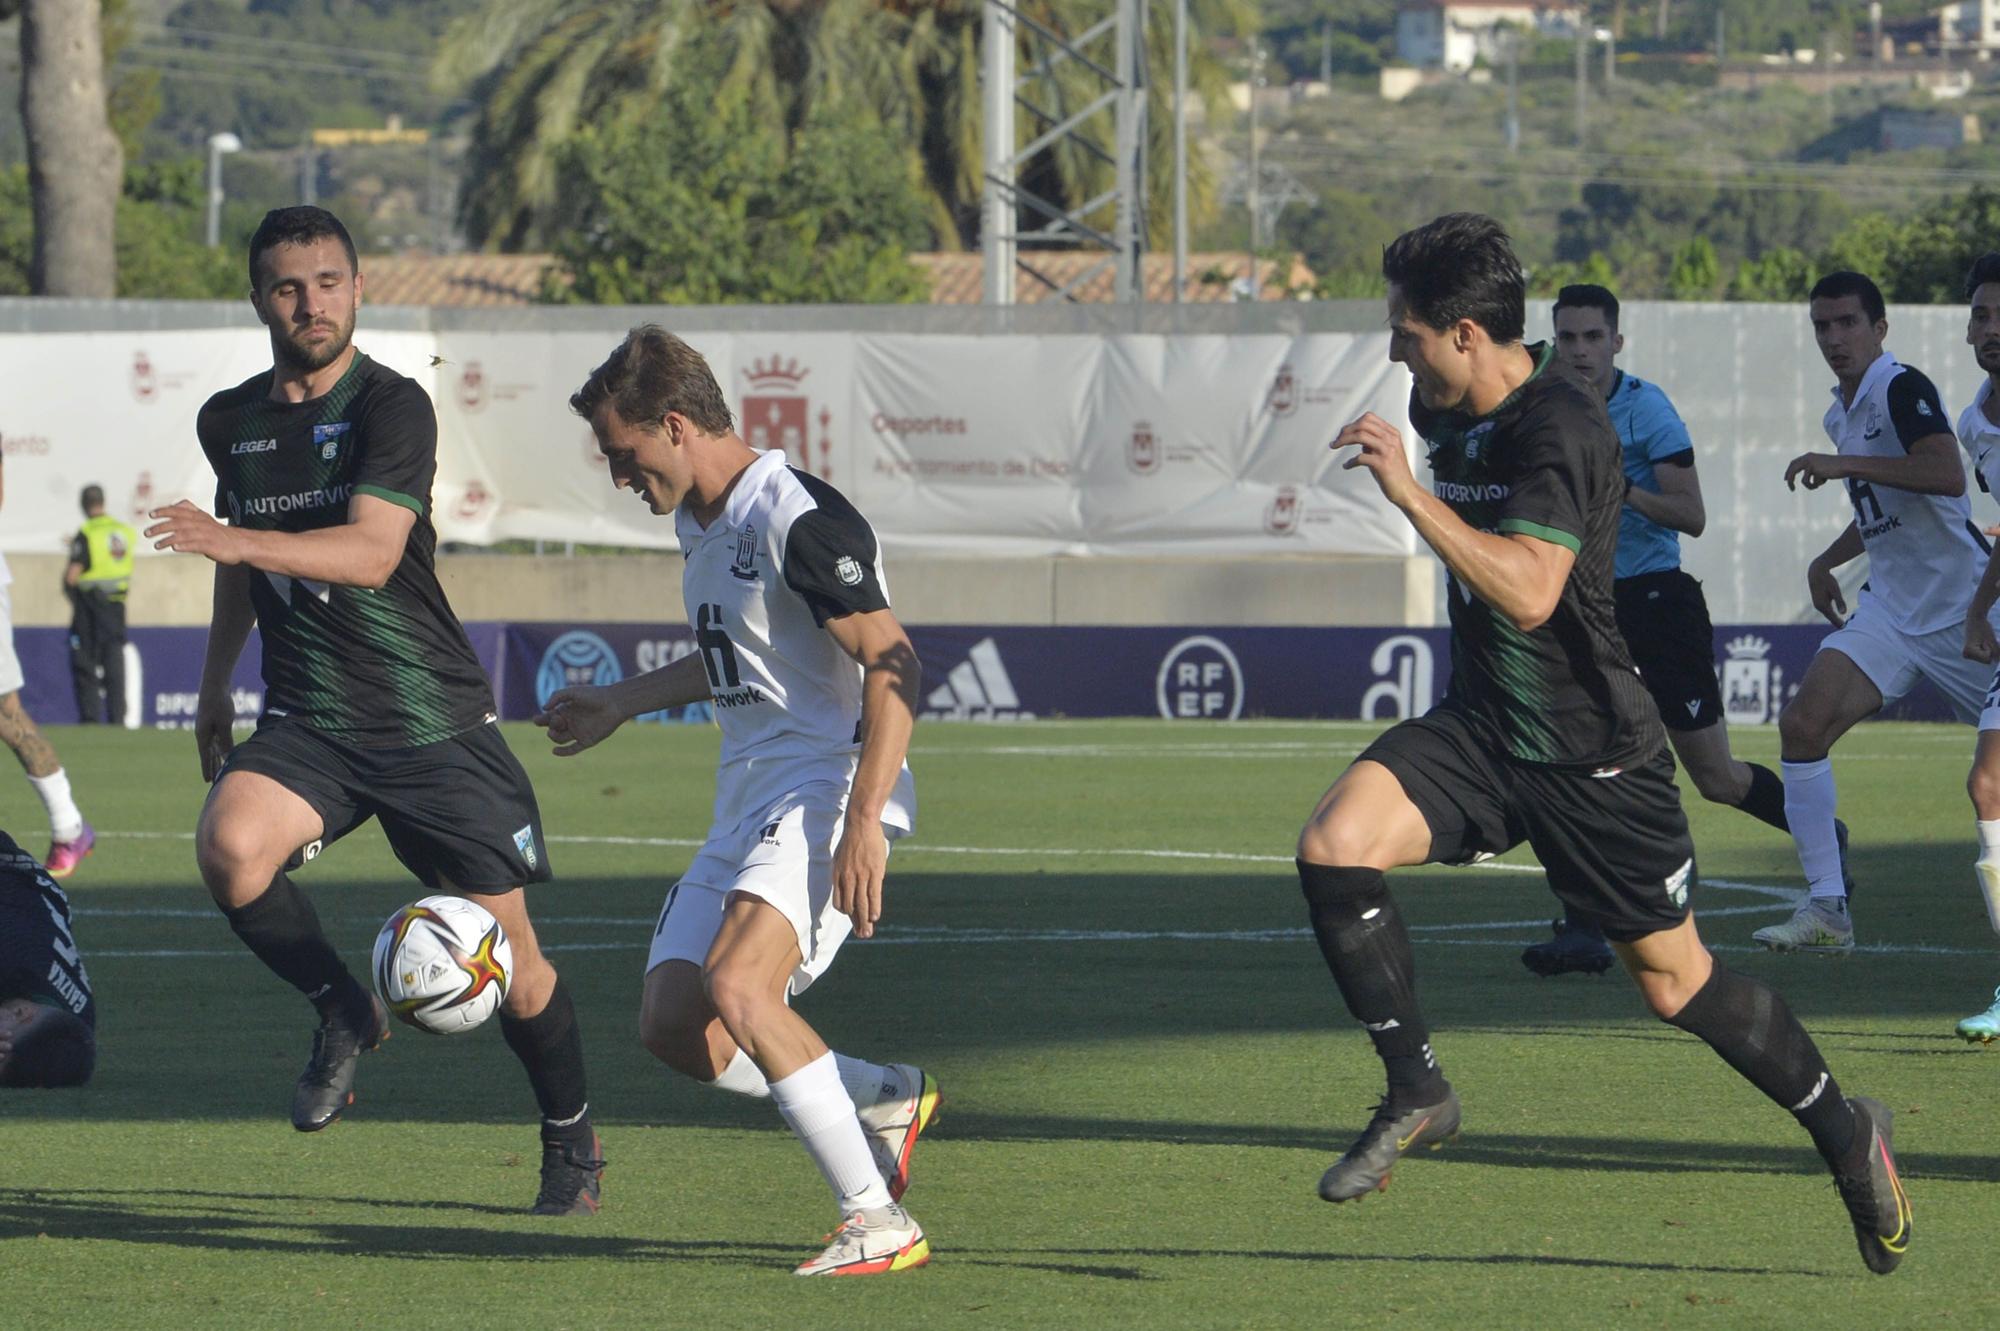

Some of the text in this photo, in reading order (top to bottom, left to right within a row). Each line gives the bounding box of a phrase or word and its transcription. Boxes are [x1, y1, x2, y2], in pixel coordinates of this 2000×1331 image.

[873, 414, 967, 438] Deportes
[231, 439, 277, 454] LEGEA
[1004, 459, 1025, 475] de
[1178, 662, 1224, 687] RF
[1178, 691, 1224, 716] EF
